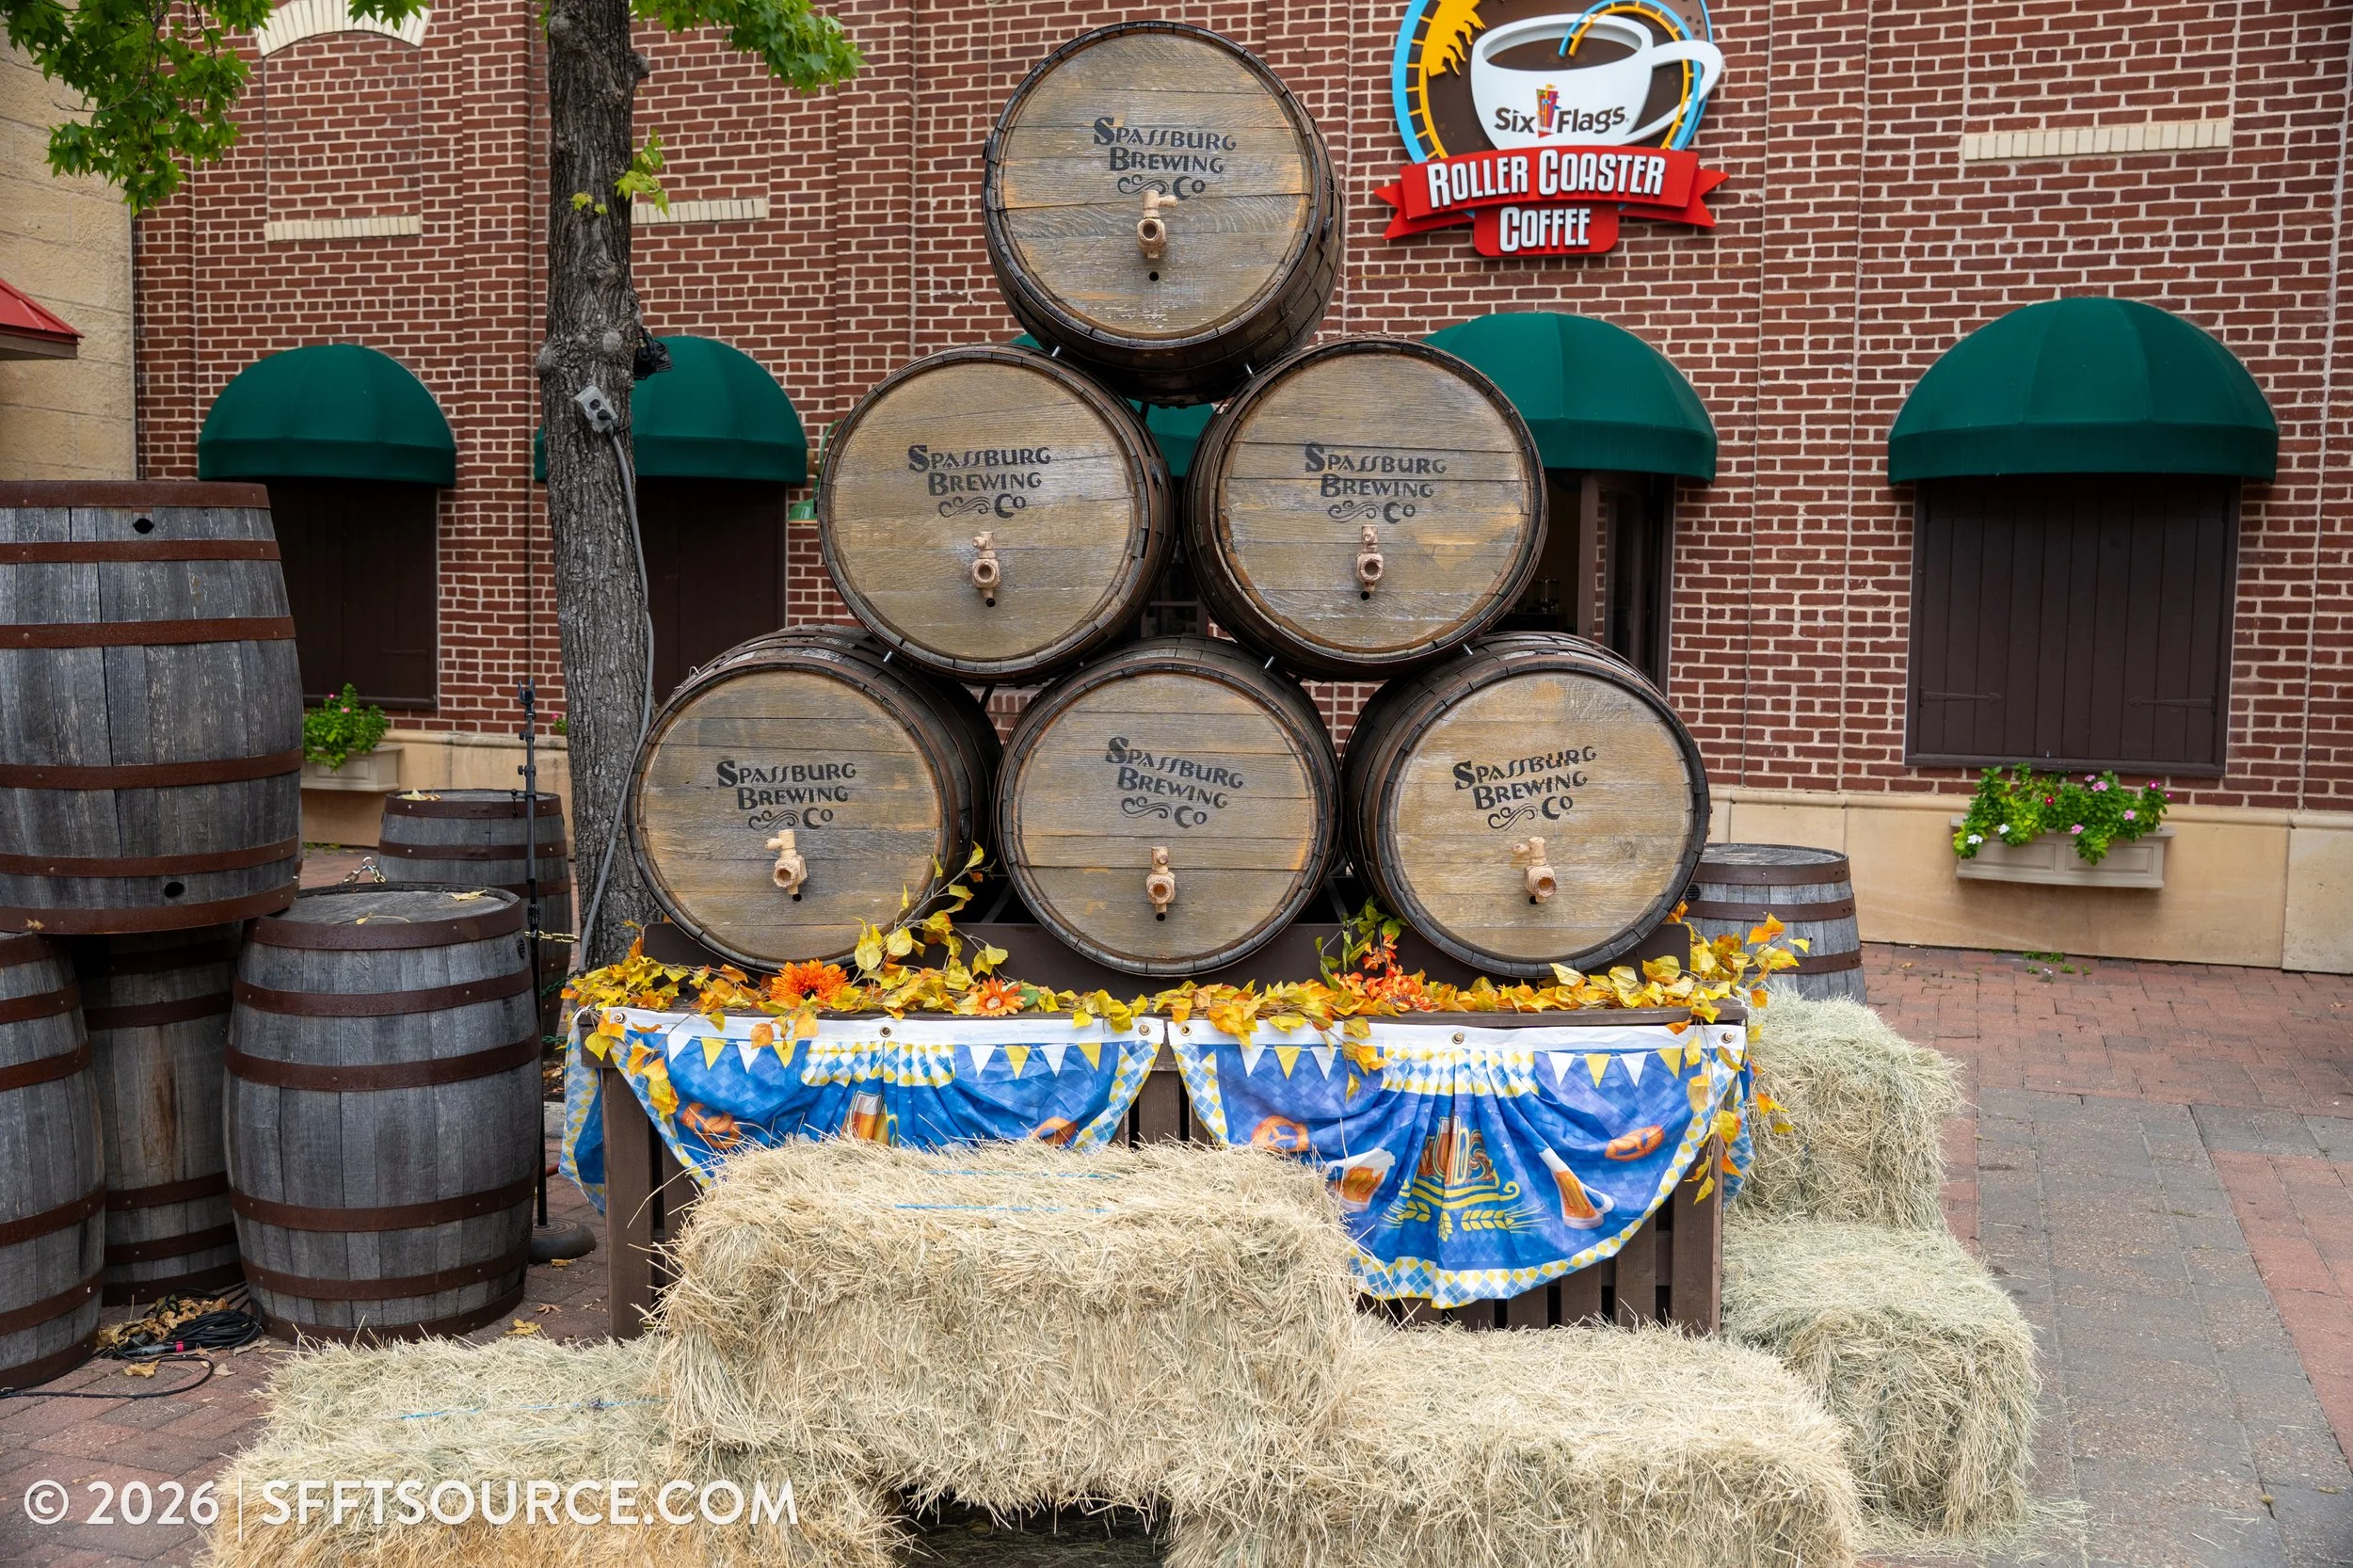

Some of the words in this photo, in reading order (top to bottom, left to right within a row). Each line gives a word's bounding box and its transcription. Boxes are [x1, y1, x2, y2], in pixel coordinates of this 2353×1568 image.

[1494, 106, 1539, 135] Six
[1557, 106, 1626, 135] Flags
[1110, 146, 1225, 174] BREWING
[1427, 155, 1529, 209] ROLLER
[1538, 150, 1666, 196] COASTER
[1499, 206, 1591, 252] COFFEE
[928, 472, 1043, 497] BREWING
[1320, 472, 1435, 499] BREWING
[736, 785, 850, 810] BREWING
[1117, 766, 1228, 809] BREWING
[1472, 770, 1589, 810] BREWING
